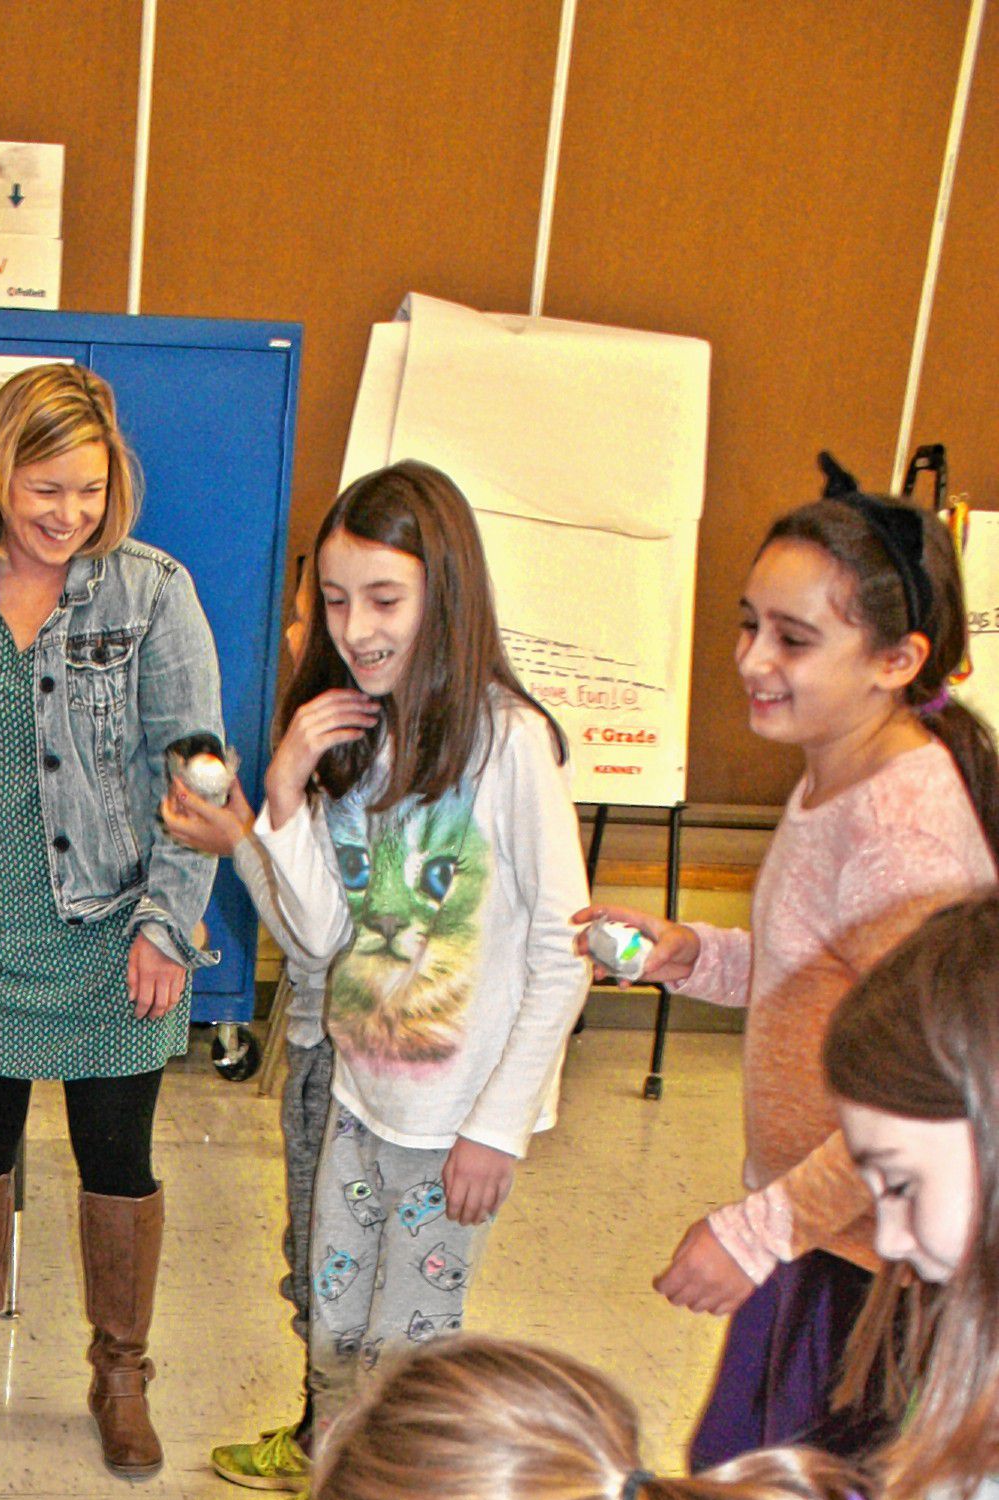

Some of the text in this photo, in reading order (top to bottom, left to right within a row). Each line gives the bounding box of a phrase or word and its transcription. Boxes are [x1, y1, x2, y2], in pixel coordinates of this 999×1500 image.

[530, 682, 567, 700] Have
[576, 684, 617, 706] fun!
[601, 728, 657, 744] Grade
